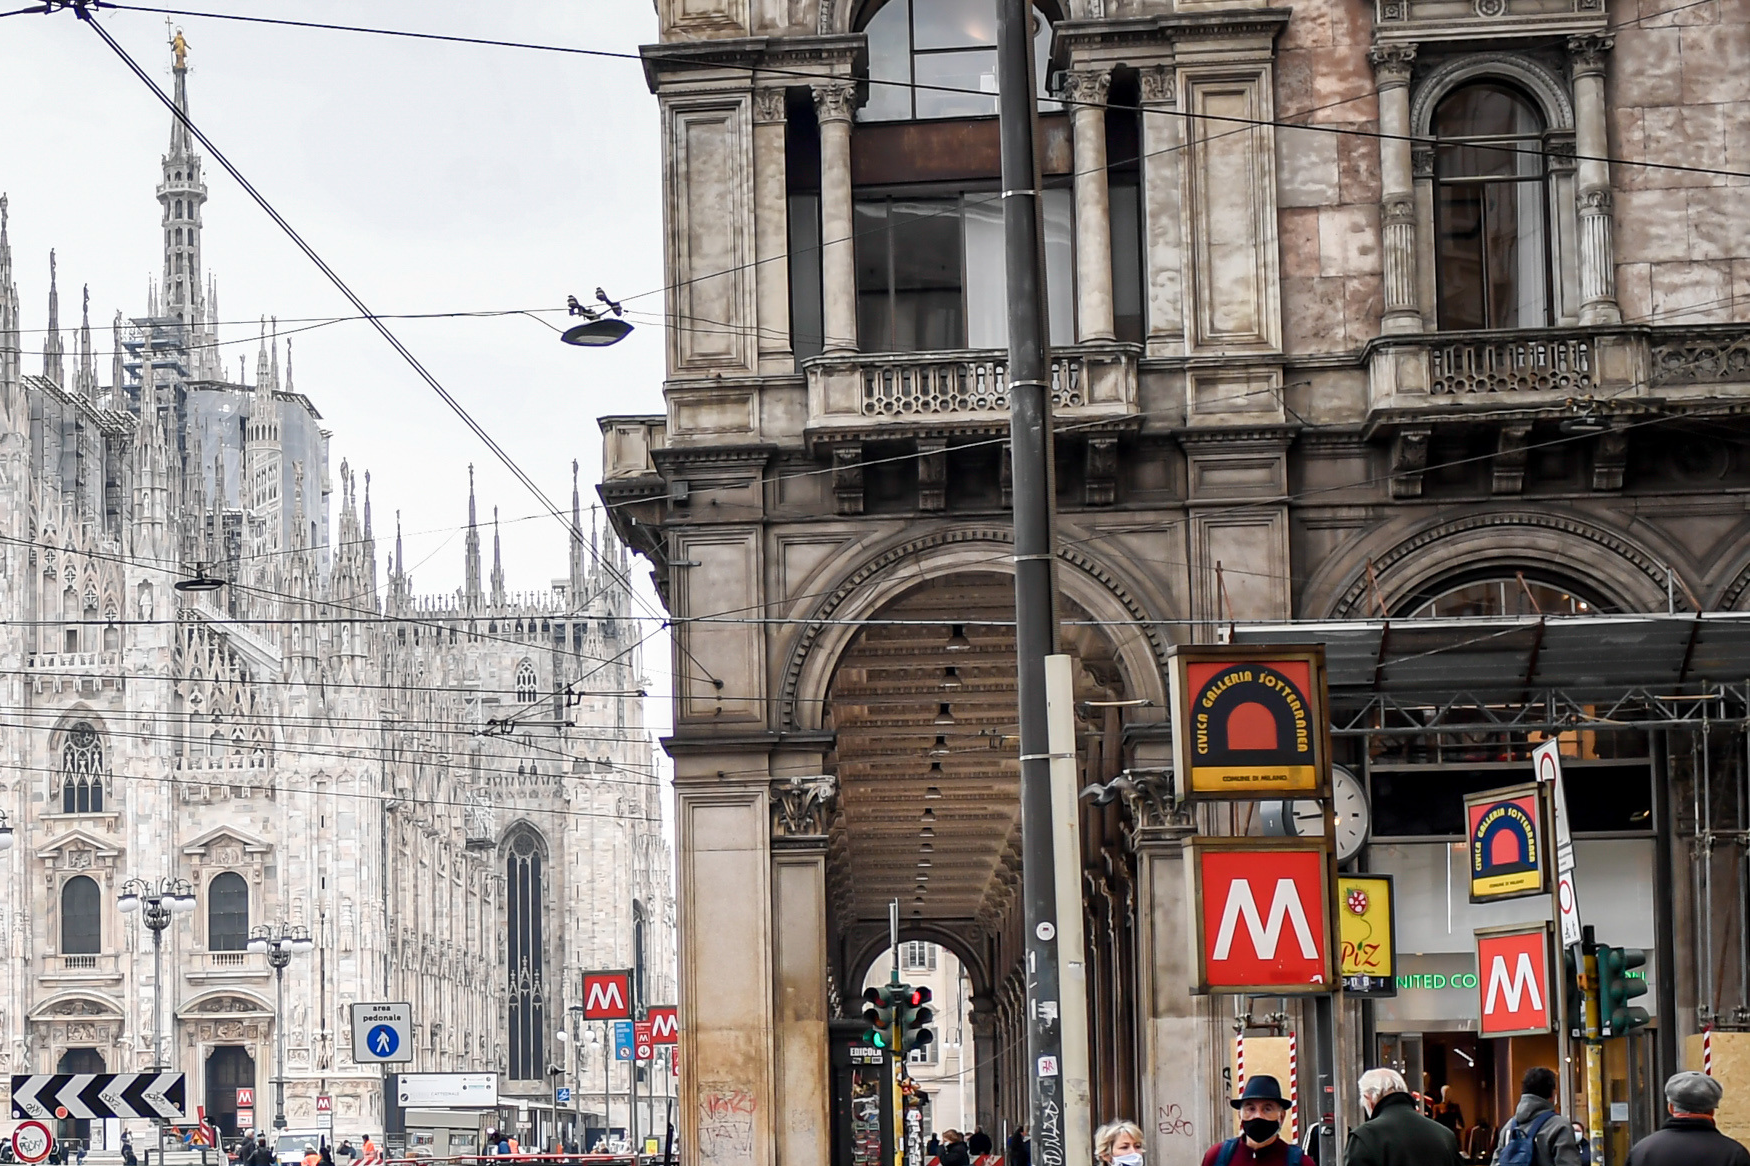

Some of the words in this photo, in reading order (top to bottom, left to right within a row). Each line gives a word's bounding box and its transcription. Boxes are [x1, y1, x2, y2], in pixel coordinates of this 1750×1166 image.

[1196, 713, 1208, 755] CIVICA
[1202, 670, 1253, 708] GALLERIA
[1258, 672, 1309, 753] SOTTERRANEA
[1477, 807, 1505, 838] GALLERIA
[1507, 807, 1536, 863] SOTTERRANEA
[1212, 878, 1319, 960] M
[1396, 973, 1447, 989] NITED
[1450, 973, 1478, 989] CO
[1483, 952, 1543, 1015] M
[586, 982, 624, 1010] M
[362, 1014, 402, 1022] pedonale
[652, 1014, 678, 1037] M
[238, 1091, 252, 1103] M
[317, 1099, 330, 1109] M
[1159, 1104, 1183, 1119] NO
[1158, 1119, 1193, 1137] EXPO
